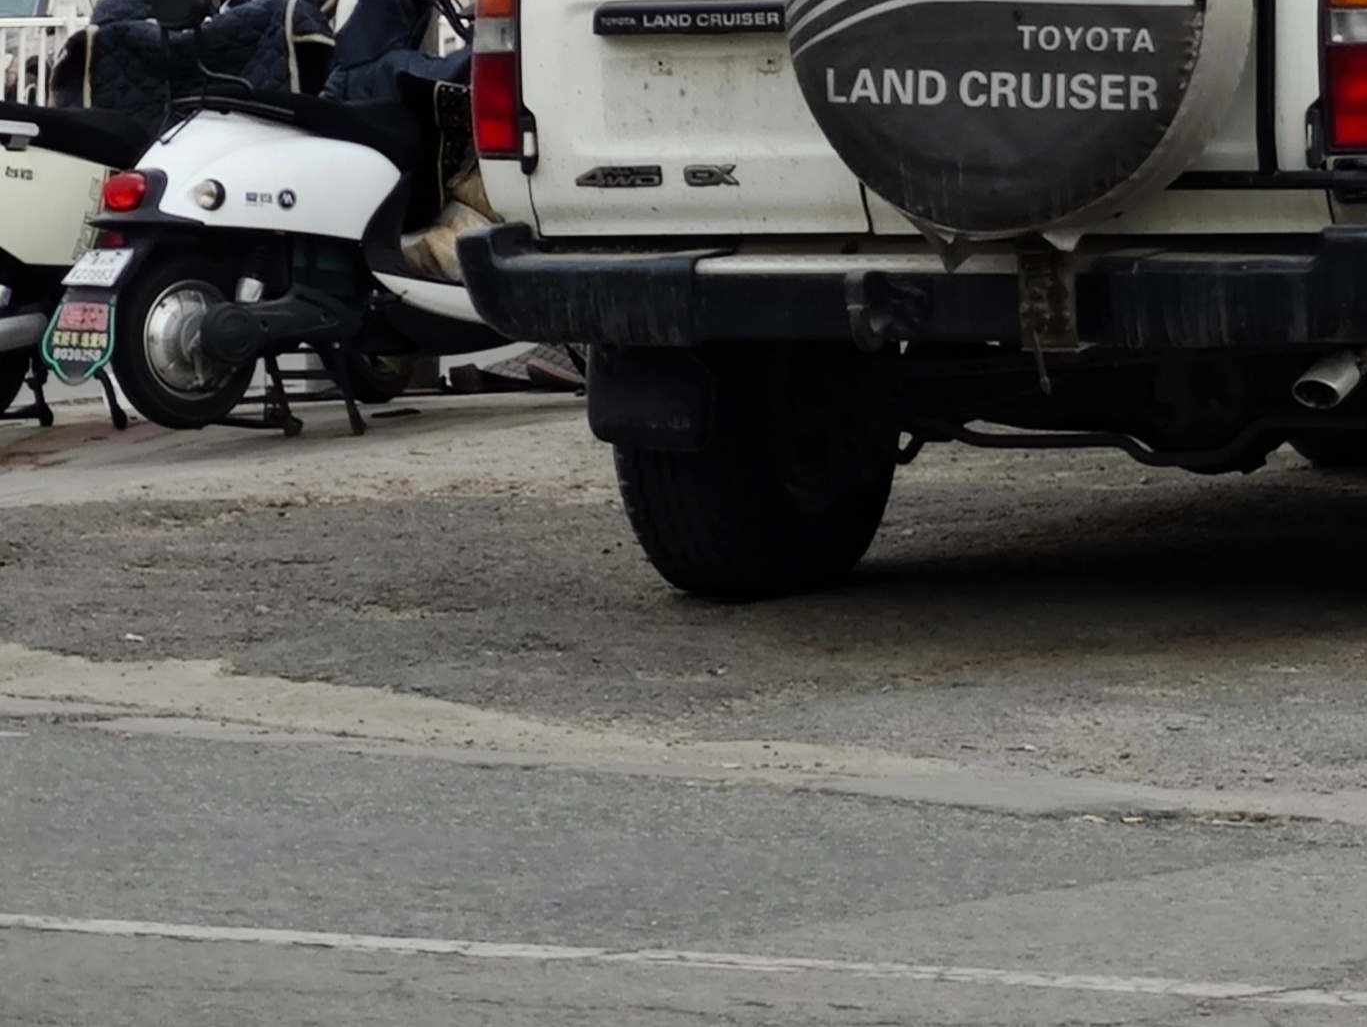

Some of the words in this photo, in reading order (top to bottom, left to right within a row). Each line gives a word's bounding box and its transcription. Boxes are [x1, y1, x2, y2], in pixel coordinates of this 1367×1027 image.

[642, 13, 692, 28] LAND
[696, 11, 780, 27] CRUISER
[1017, 24, 1155, 54] TOYOTA
[826, 68, 947, 106] LAND
[959, 71, 1159, 112] CRUISER
